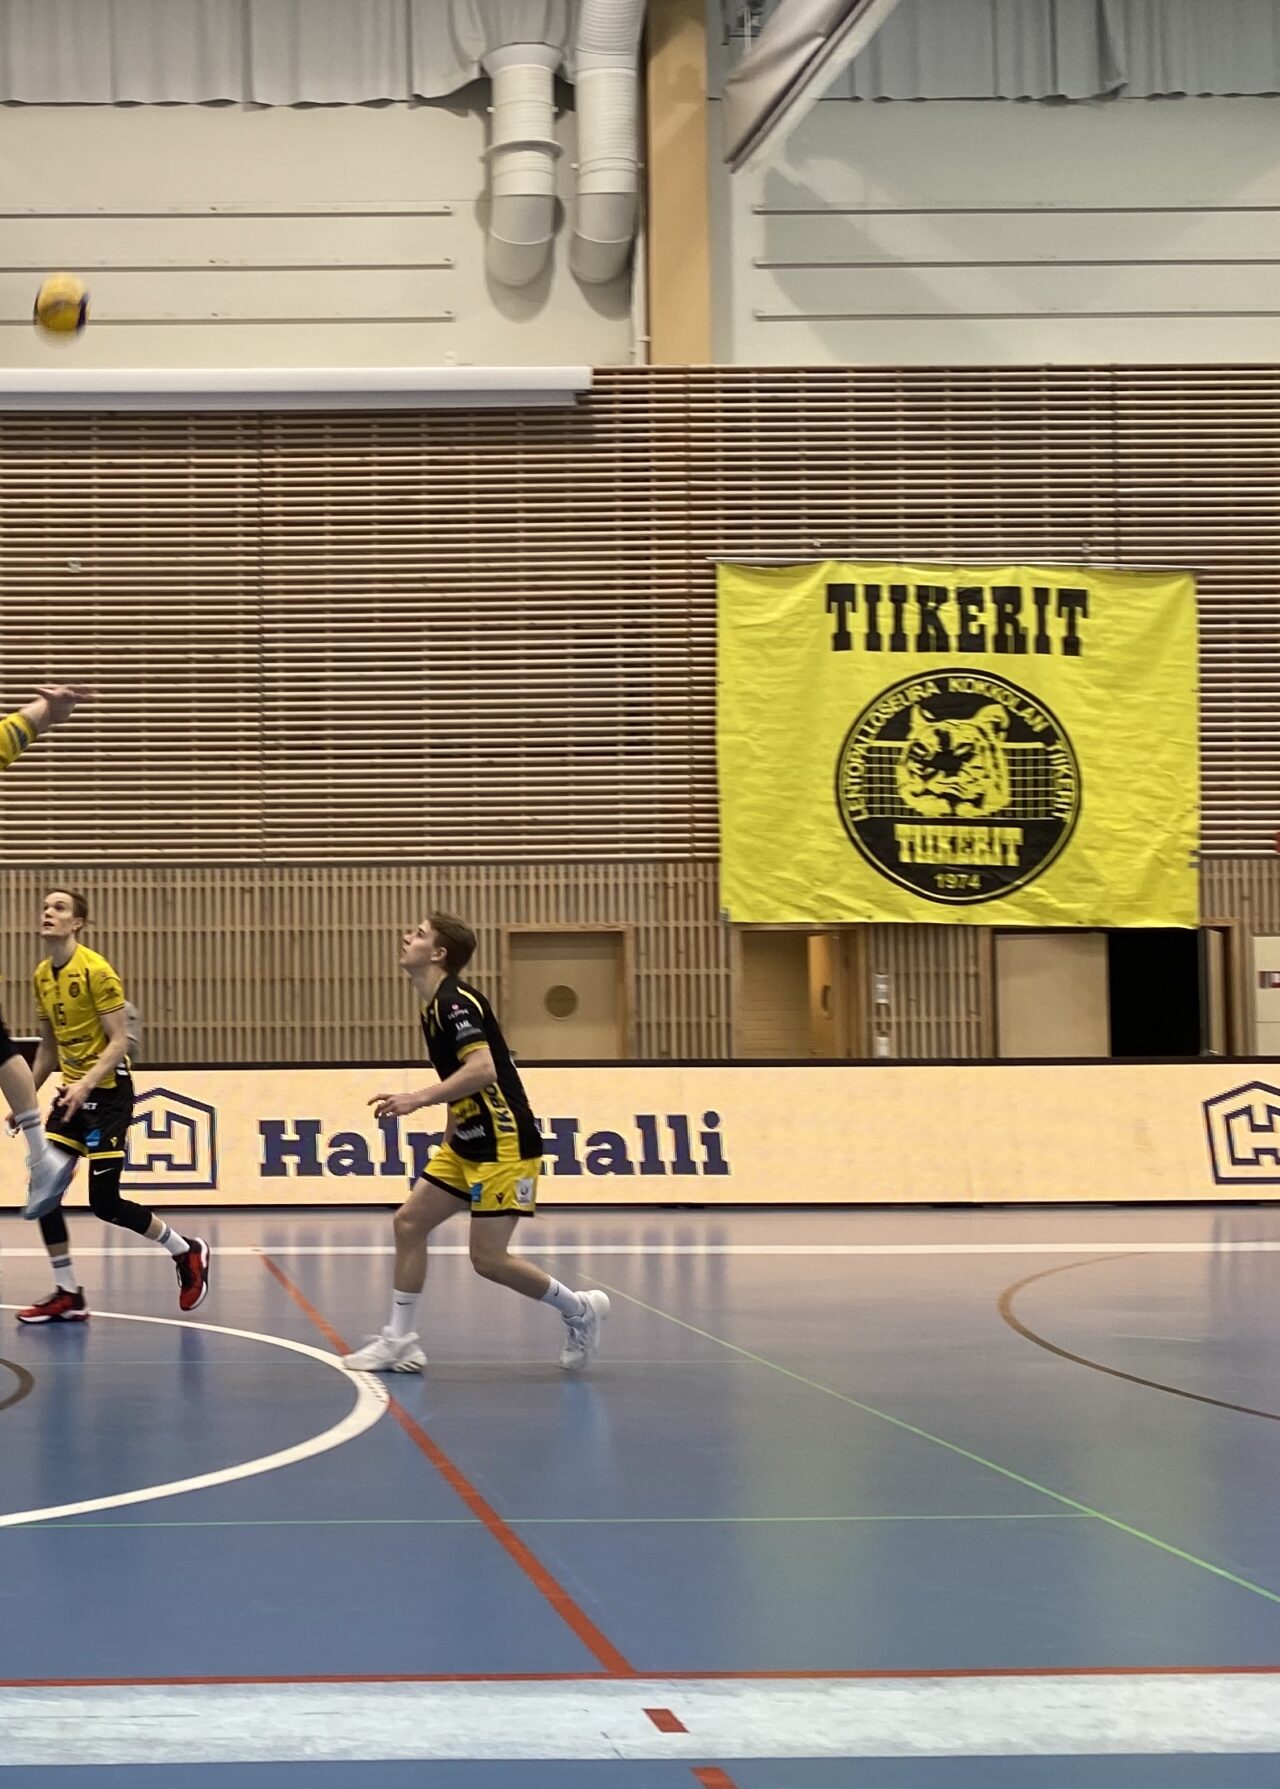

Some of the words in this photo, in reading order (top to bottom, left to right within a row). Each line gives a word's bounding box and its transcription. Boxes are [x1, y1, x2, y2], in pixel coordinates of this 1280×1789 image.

[824, 582, 1090, 657] TIIKERIT
[894, 823, 1024, 867] TIIKERIT
[933, 873, 982, 890] 1974
[258, 1110, 731, 1190] HalpHalli
